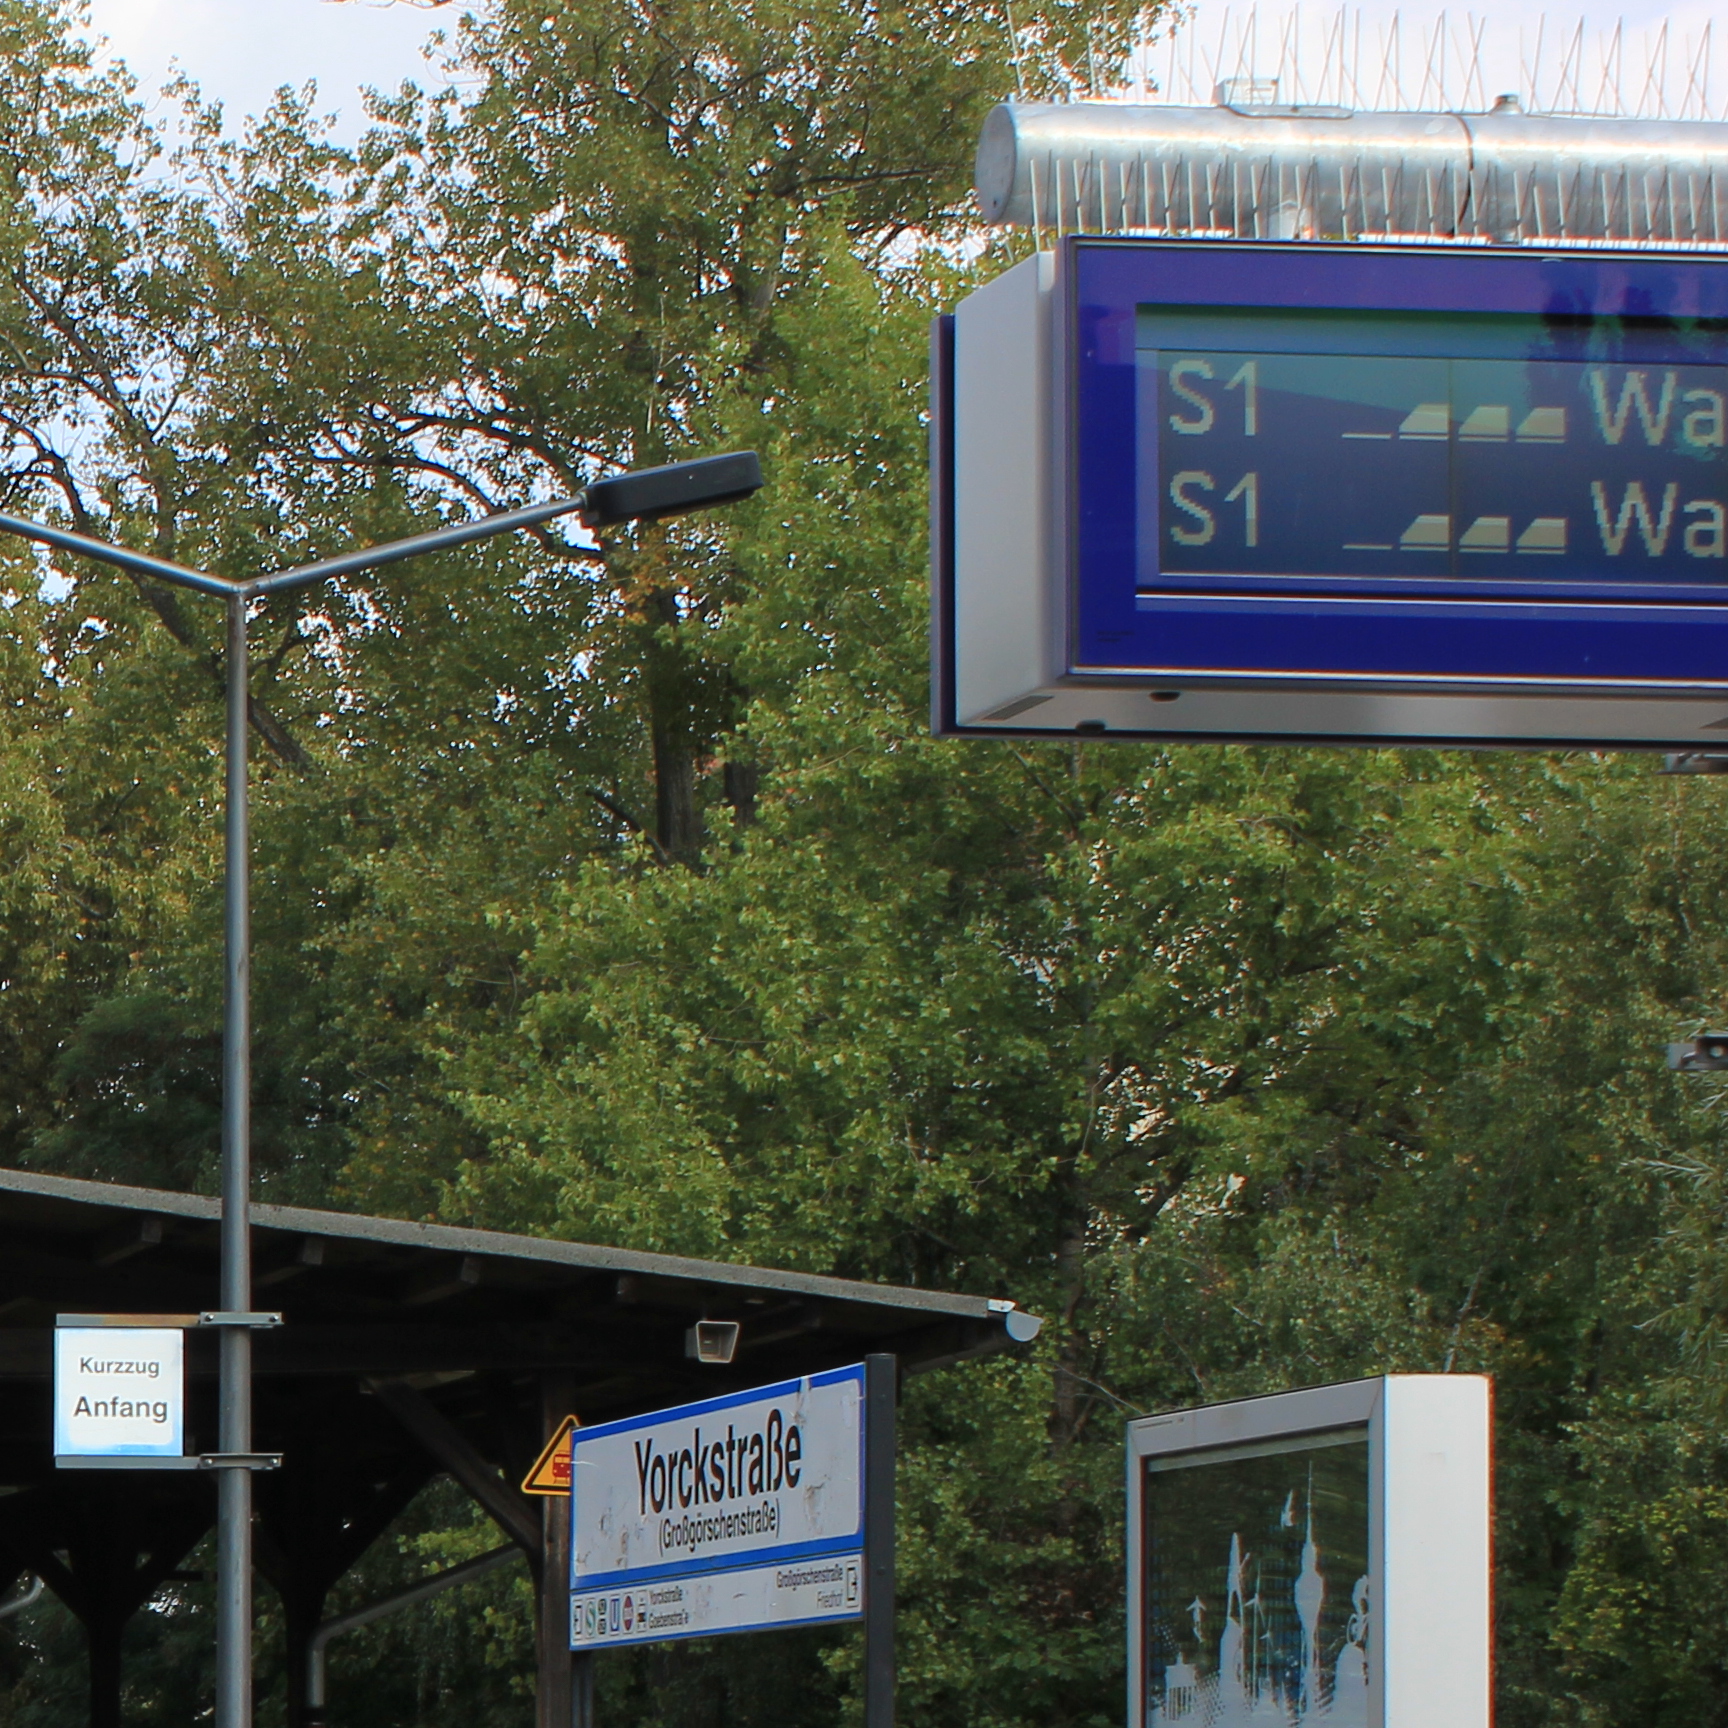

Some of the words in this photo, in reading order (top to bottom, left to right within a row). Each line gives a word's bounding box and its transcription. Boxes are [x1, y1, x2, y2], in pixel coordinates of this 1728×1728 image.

[1168, 358, 1258, 436] S1
[1589, 369, 1727, 447] Wa
[1169, 470, 1258, 548] S1
[1590, 481, 1727, 558] Wa
[79, 1356, 160, 1379] Kurzzug
[73, 1395, 168, 1424] Anfang
[633, 1408, 802, 1516] Yorckstraße
[658, 1497, 781, 1558] (Großgörschenstraße)
